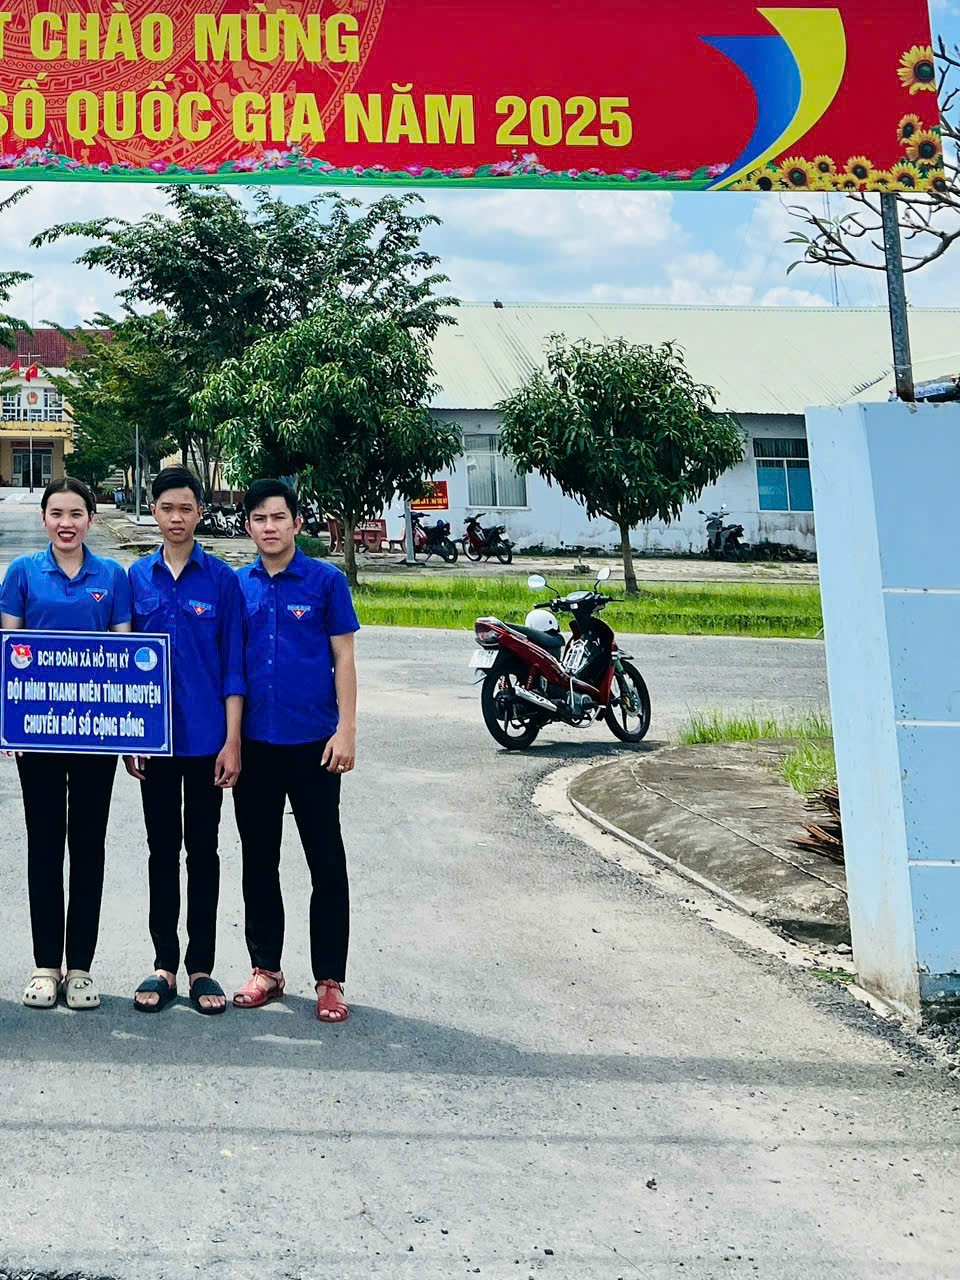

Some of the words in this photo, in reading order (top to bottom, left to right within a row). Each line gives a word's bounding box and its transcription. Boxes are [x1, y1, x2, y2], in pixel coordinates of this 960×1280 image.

[30, 3, 173, 61] CHÀO
[194, 3, 360, 63] MỪNG
[66, 73, 212, 144] QUỐC
[232, 91, 325, 143] GIA
[344, 83, 475, 145] NĂM
[495, 96, 633, 147] 2025
[38, 650, 54, 666] BCH
[56, 647, 78, 667] ĐOÀN
[80, 648, 91, 668] XÃ
[106, 653, 118, 672] THỊ
[7, 677, 22, 704] ĐỘI
[25, 678, 46, 700] HÌNH
[48, 681, 77, 702] THANH
[80, 679, 100, 702] NIÊN
[103, 680, 123, 703] TÌNH
[126, 681, 161, 708] NGUYỆN
[24, 707, 59, 734] CHUYỂN
[61, 708, 76, 735] ĐỔI
[79, 709, 91, 736] SỐ
[93, 713, 118, 740] CỘNG
